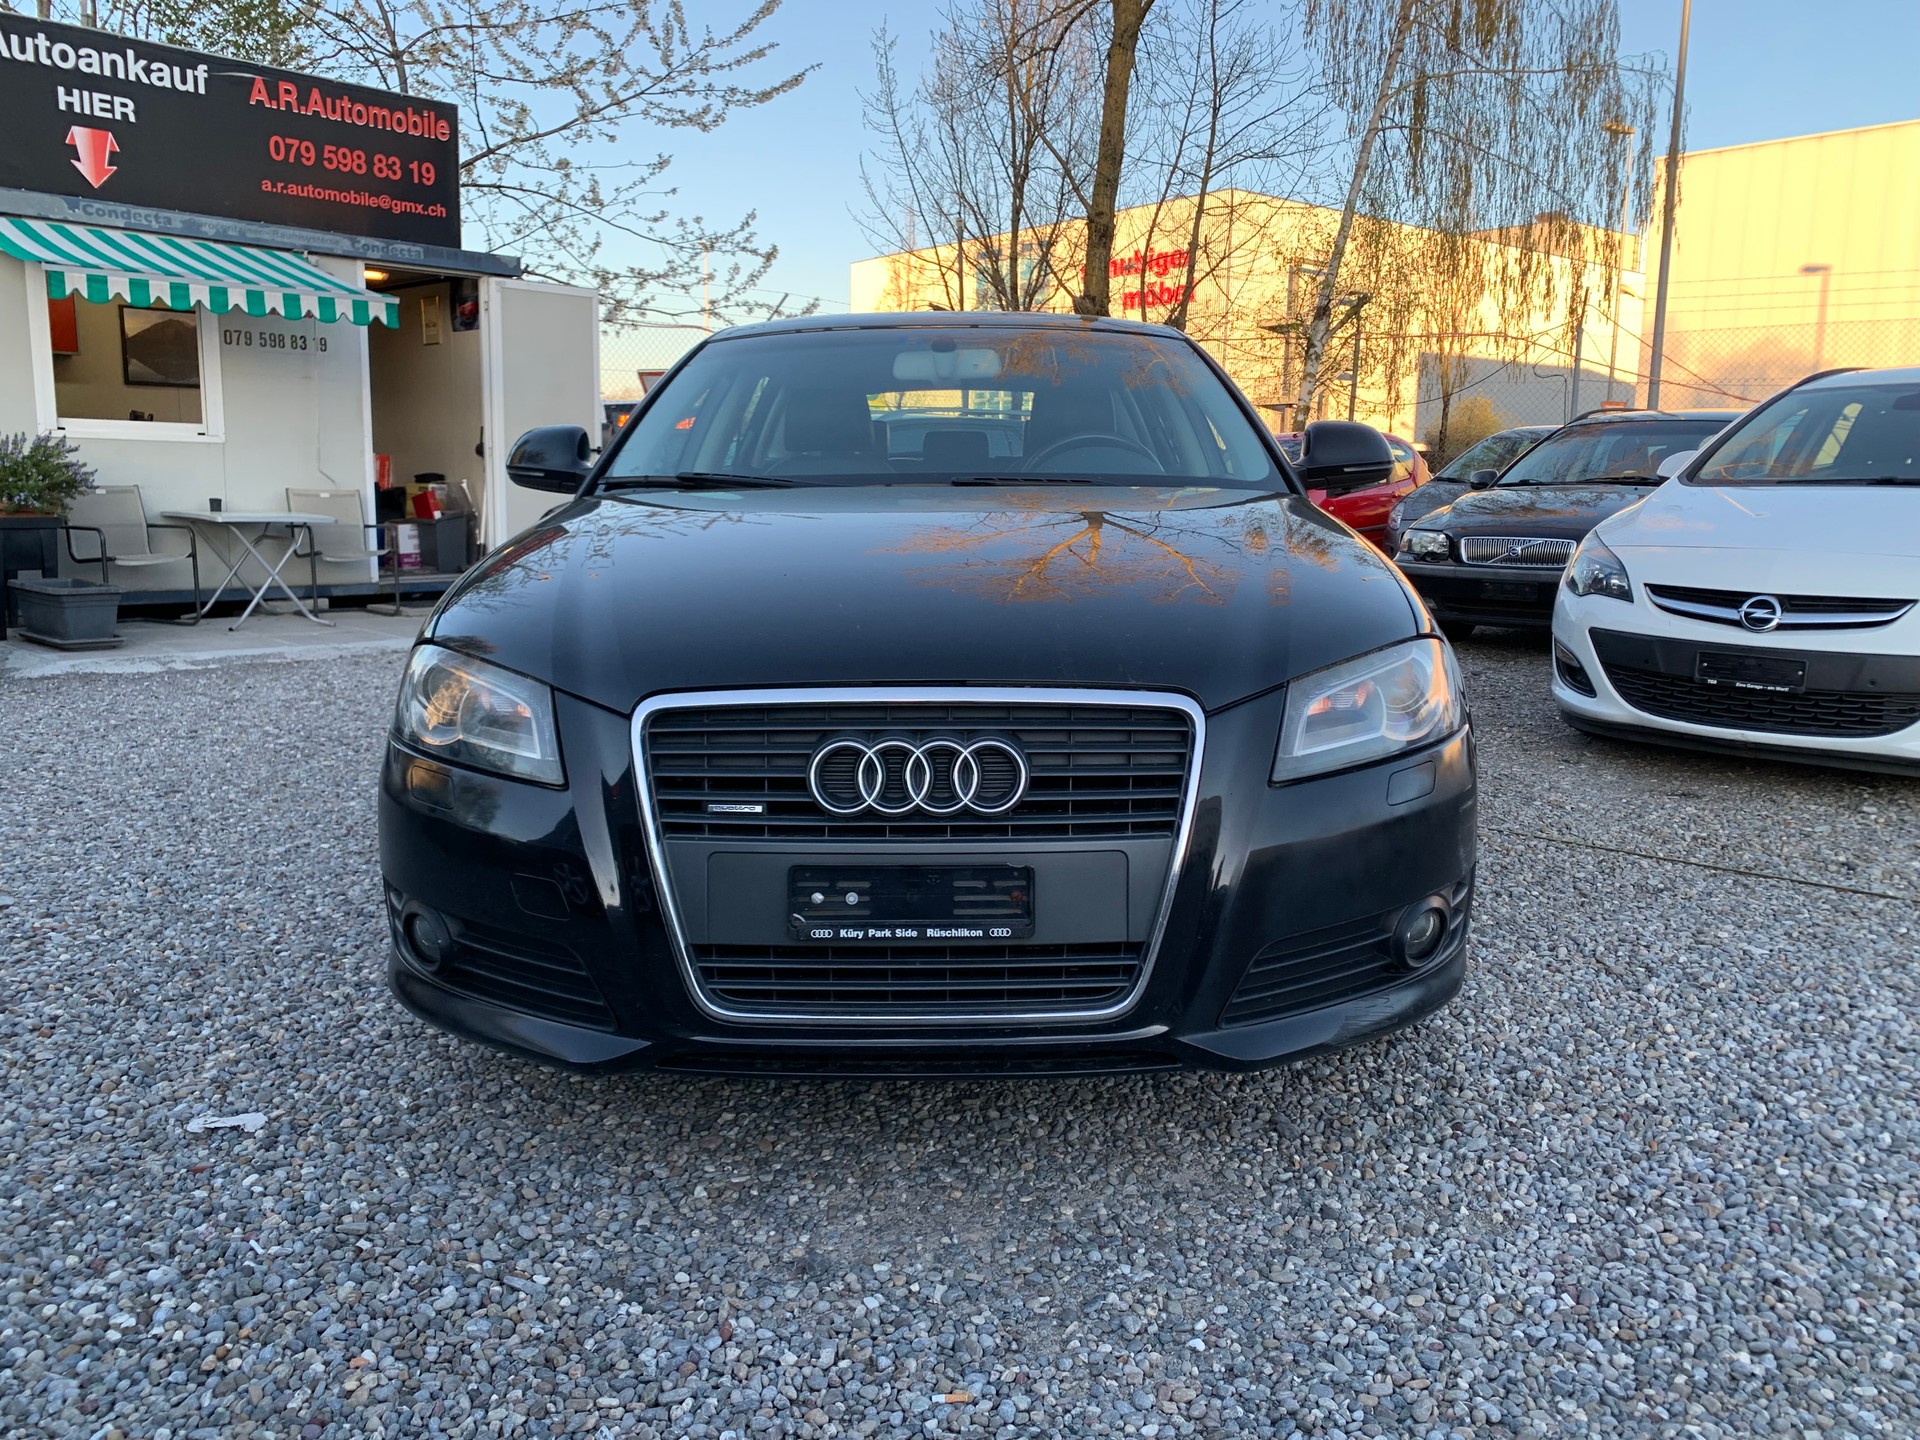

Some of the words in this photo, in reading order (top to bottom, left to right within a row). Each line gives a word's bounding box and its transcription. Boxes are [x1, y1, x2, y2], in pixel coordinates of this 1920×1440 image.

[57, 86, 136, 122] HIER
[249, 76, 450, 141] A.R.Automobile
[269, 135, 316, 166] 079
[323, 145, 367, 175] 598
[373, 154, 402, 180] 83
[409, 161, 436, 186] 19
[82, 203, 173, 226] Condecta
[261, 179, 446, 218] a.r.automobile@gmx.ch
[223, 329, 252, 346] 079
[259, 331, 286, 349] 598
[290, 334, 307, 350] 83
[313, 336, 328, 352] 9
[839, 929, 865, 939] Küry
[868, 929, 892, 938] Park
[895, 929, 918, 938] Side
[926, 928, 983, 938] Rüschlikon
